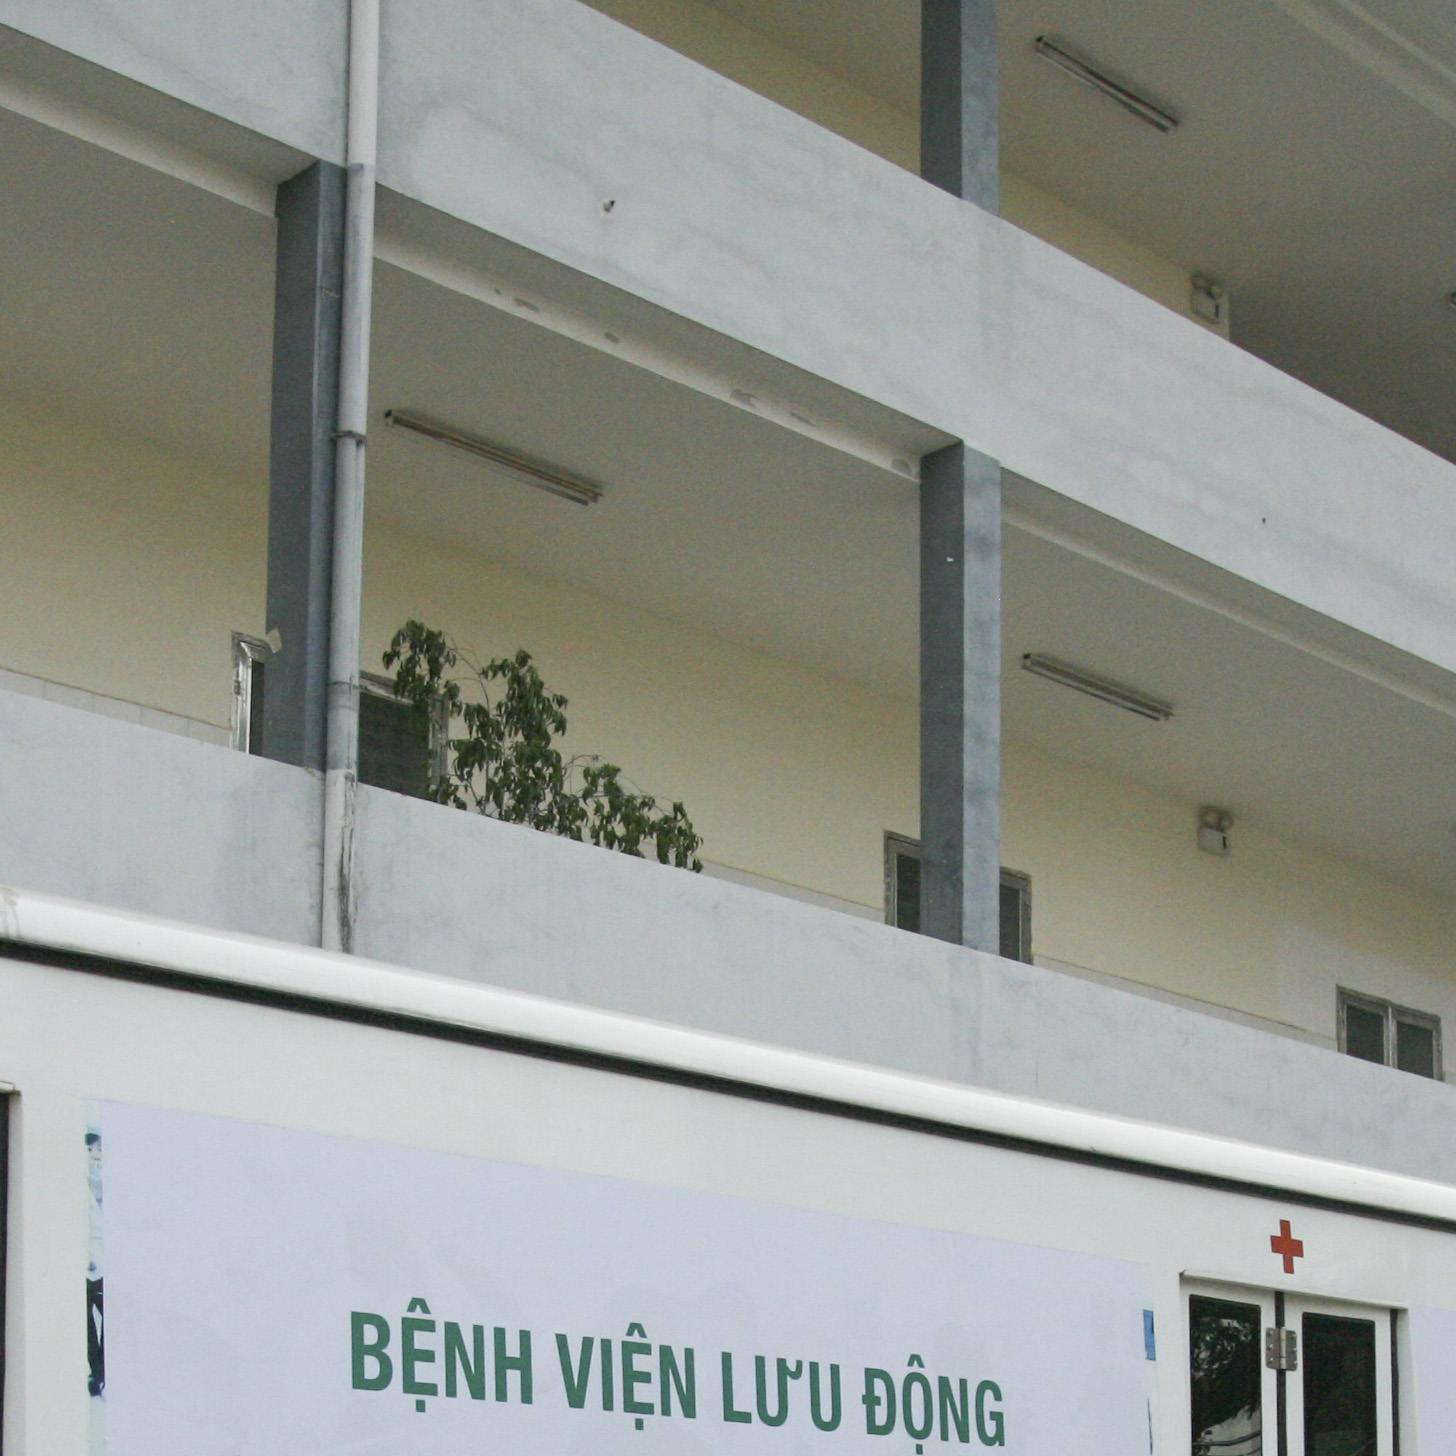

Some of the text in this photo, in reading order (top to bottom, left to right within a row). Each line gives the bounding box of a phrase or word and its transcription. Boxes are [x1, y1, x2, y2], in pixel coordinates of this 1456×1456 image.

[350, 1297, 1006, 1456] BỆNH VIỆN LƯU ĐỘNG
